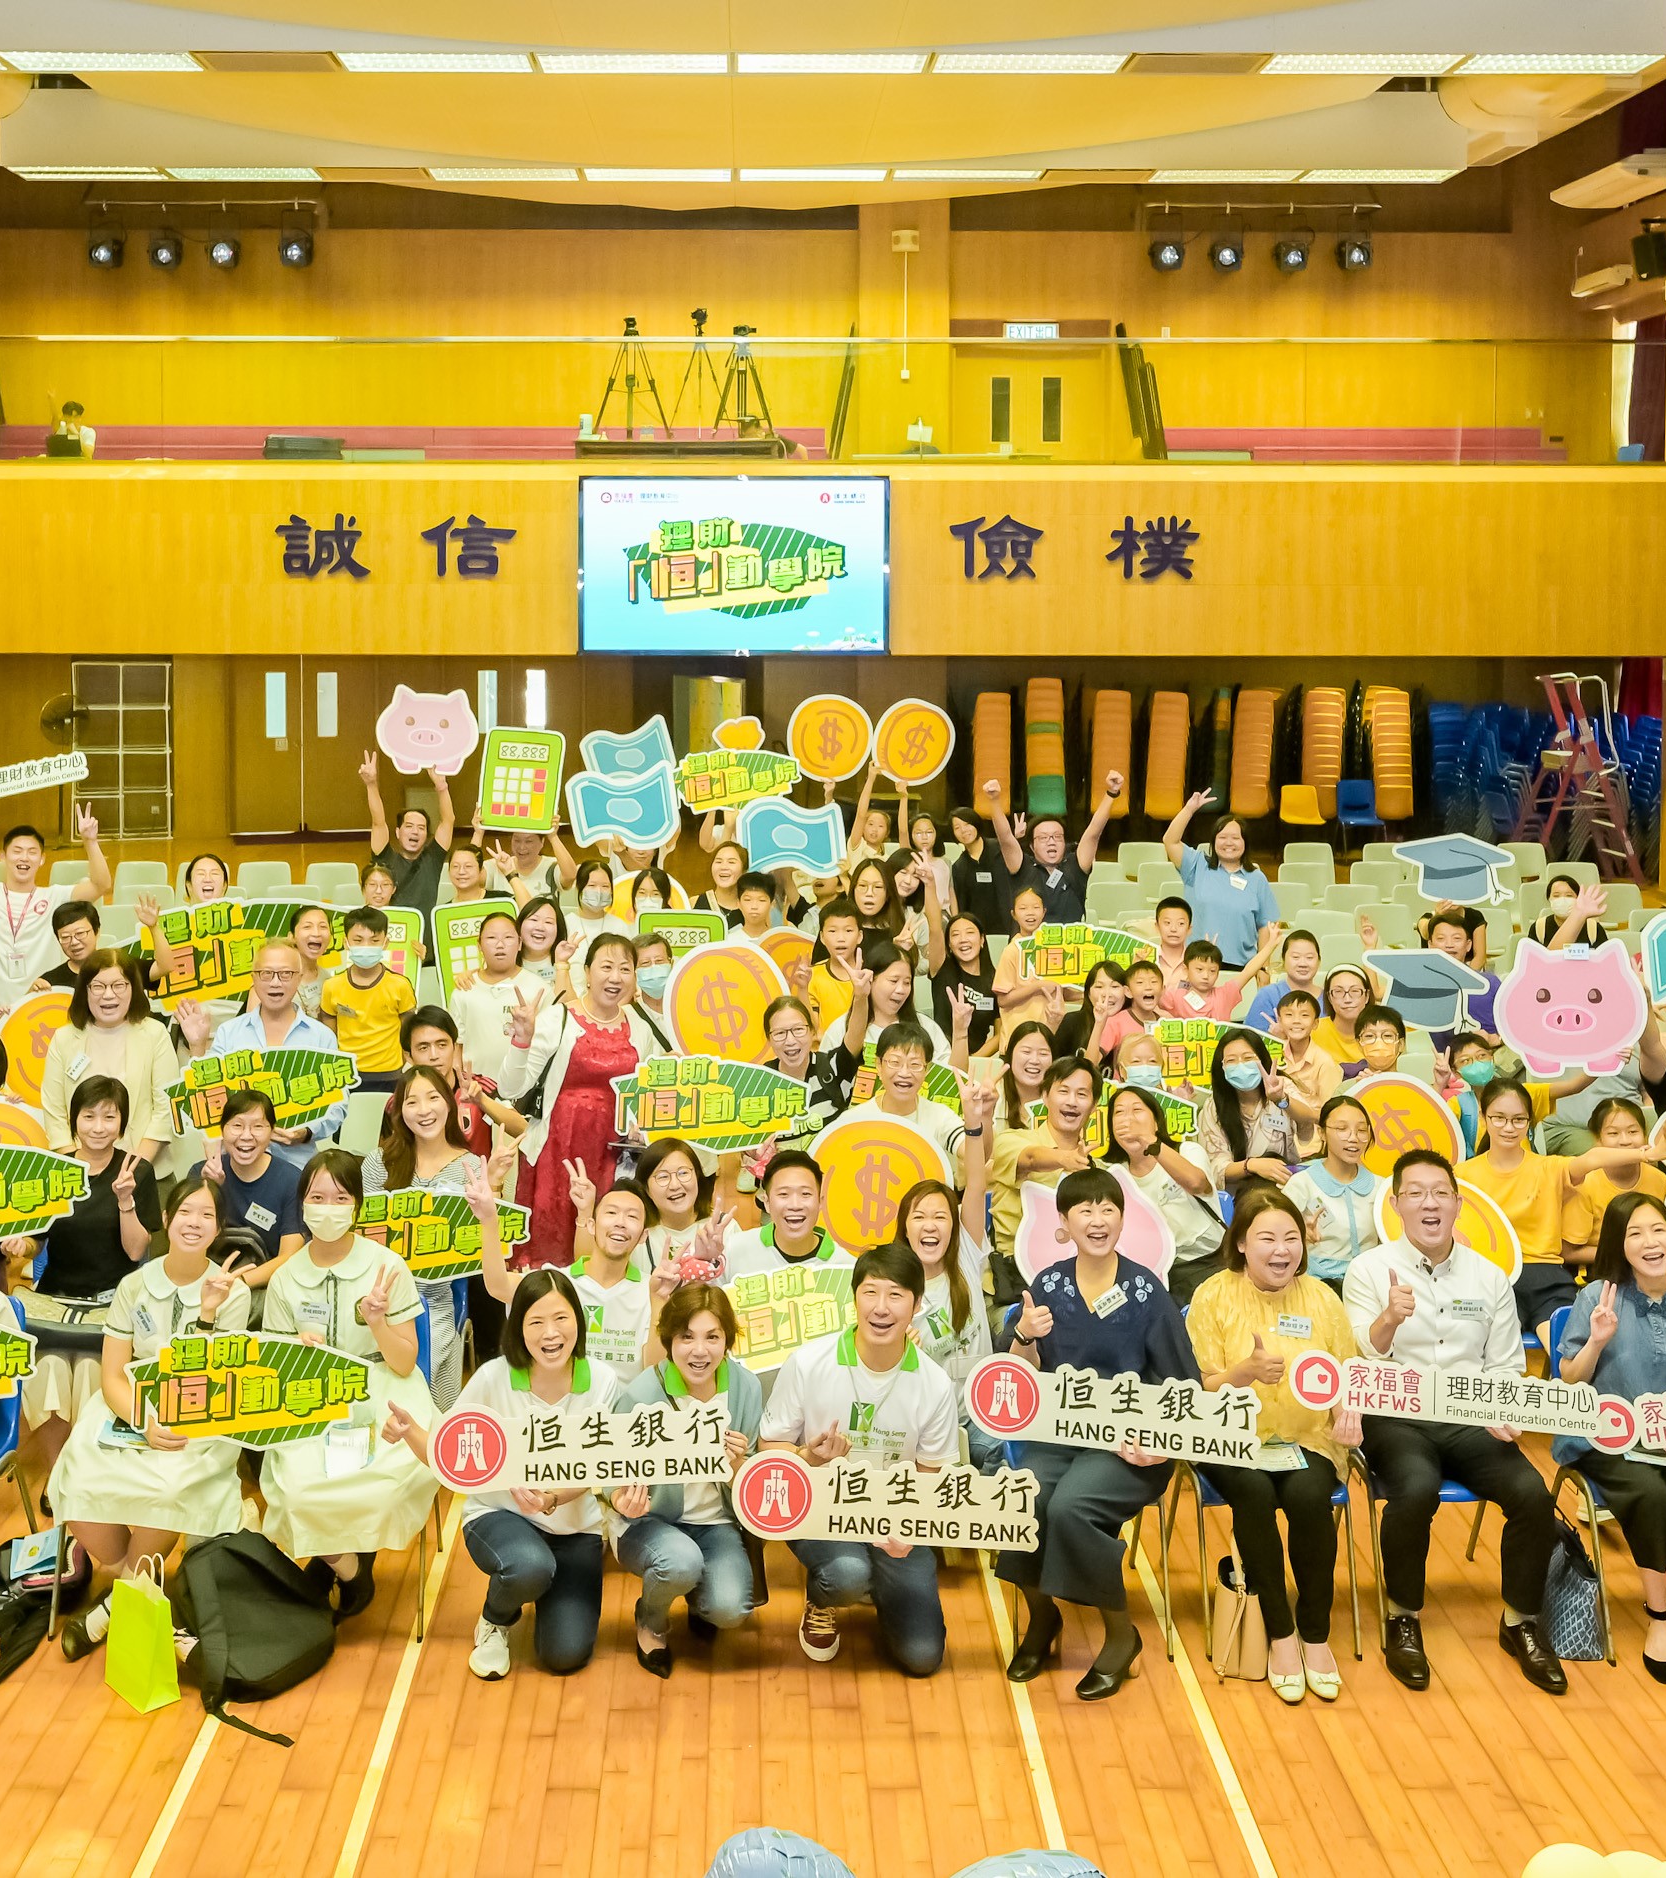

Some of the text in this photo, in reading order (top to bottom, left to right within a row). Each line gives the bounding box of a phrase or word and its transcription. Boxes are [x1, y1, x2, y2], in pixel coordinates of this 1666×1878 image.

[1009, 326, 1034, 339] EXIT
[274, 514, 518, 579] 誠信
[659, 517, 734, 552] 理財
[950, 515, 1200, 582] 儉樸
[26, 775, 61, 787] Education
[61, 769, 85, 780] Centre
[687, 750, 731, 776] 理財
[158, 902, 234, 943] 理財
[1042, 924, 1088, 945] 理財
[1161, 1019, 1211, 1042] 理財
[191, 1049, 256, 1087] 理財
[647, 1056, 715, 1088] 理財
[357, 1190, 427, 1222] 理財
[735, 1265, 808, 1308] 理財
[169, 1334, 251, 1373] 理財
[1055, 1371, 1256, 1430] 恒生銀行
[1347, 1391, 1422, 1415] HKFWS
[1348, 1363, 1596, 1414] 家福會 理財教育中心
[522, 1408, 725, 1453] 恒生銀行
[1445, 1404, 1598, 1432] Financial Education Centre
[1055, 1419, 1255, 1460] HANG SENG BANK
[525, 1456, 726, 1482] HANG SENG BANK
[828, 1463, 1034, 1512] 恒生銀行
[828, 1515, 1032, 1544] HANG SENG BANK
